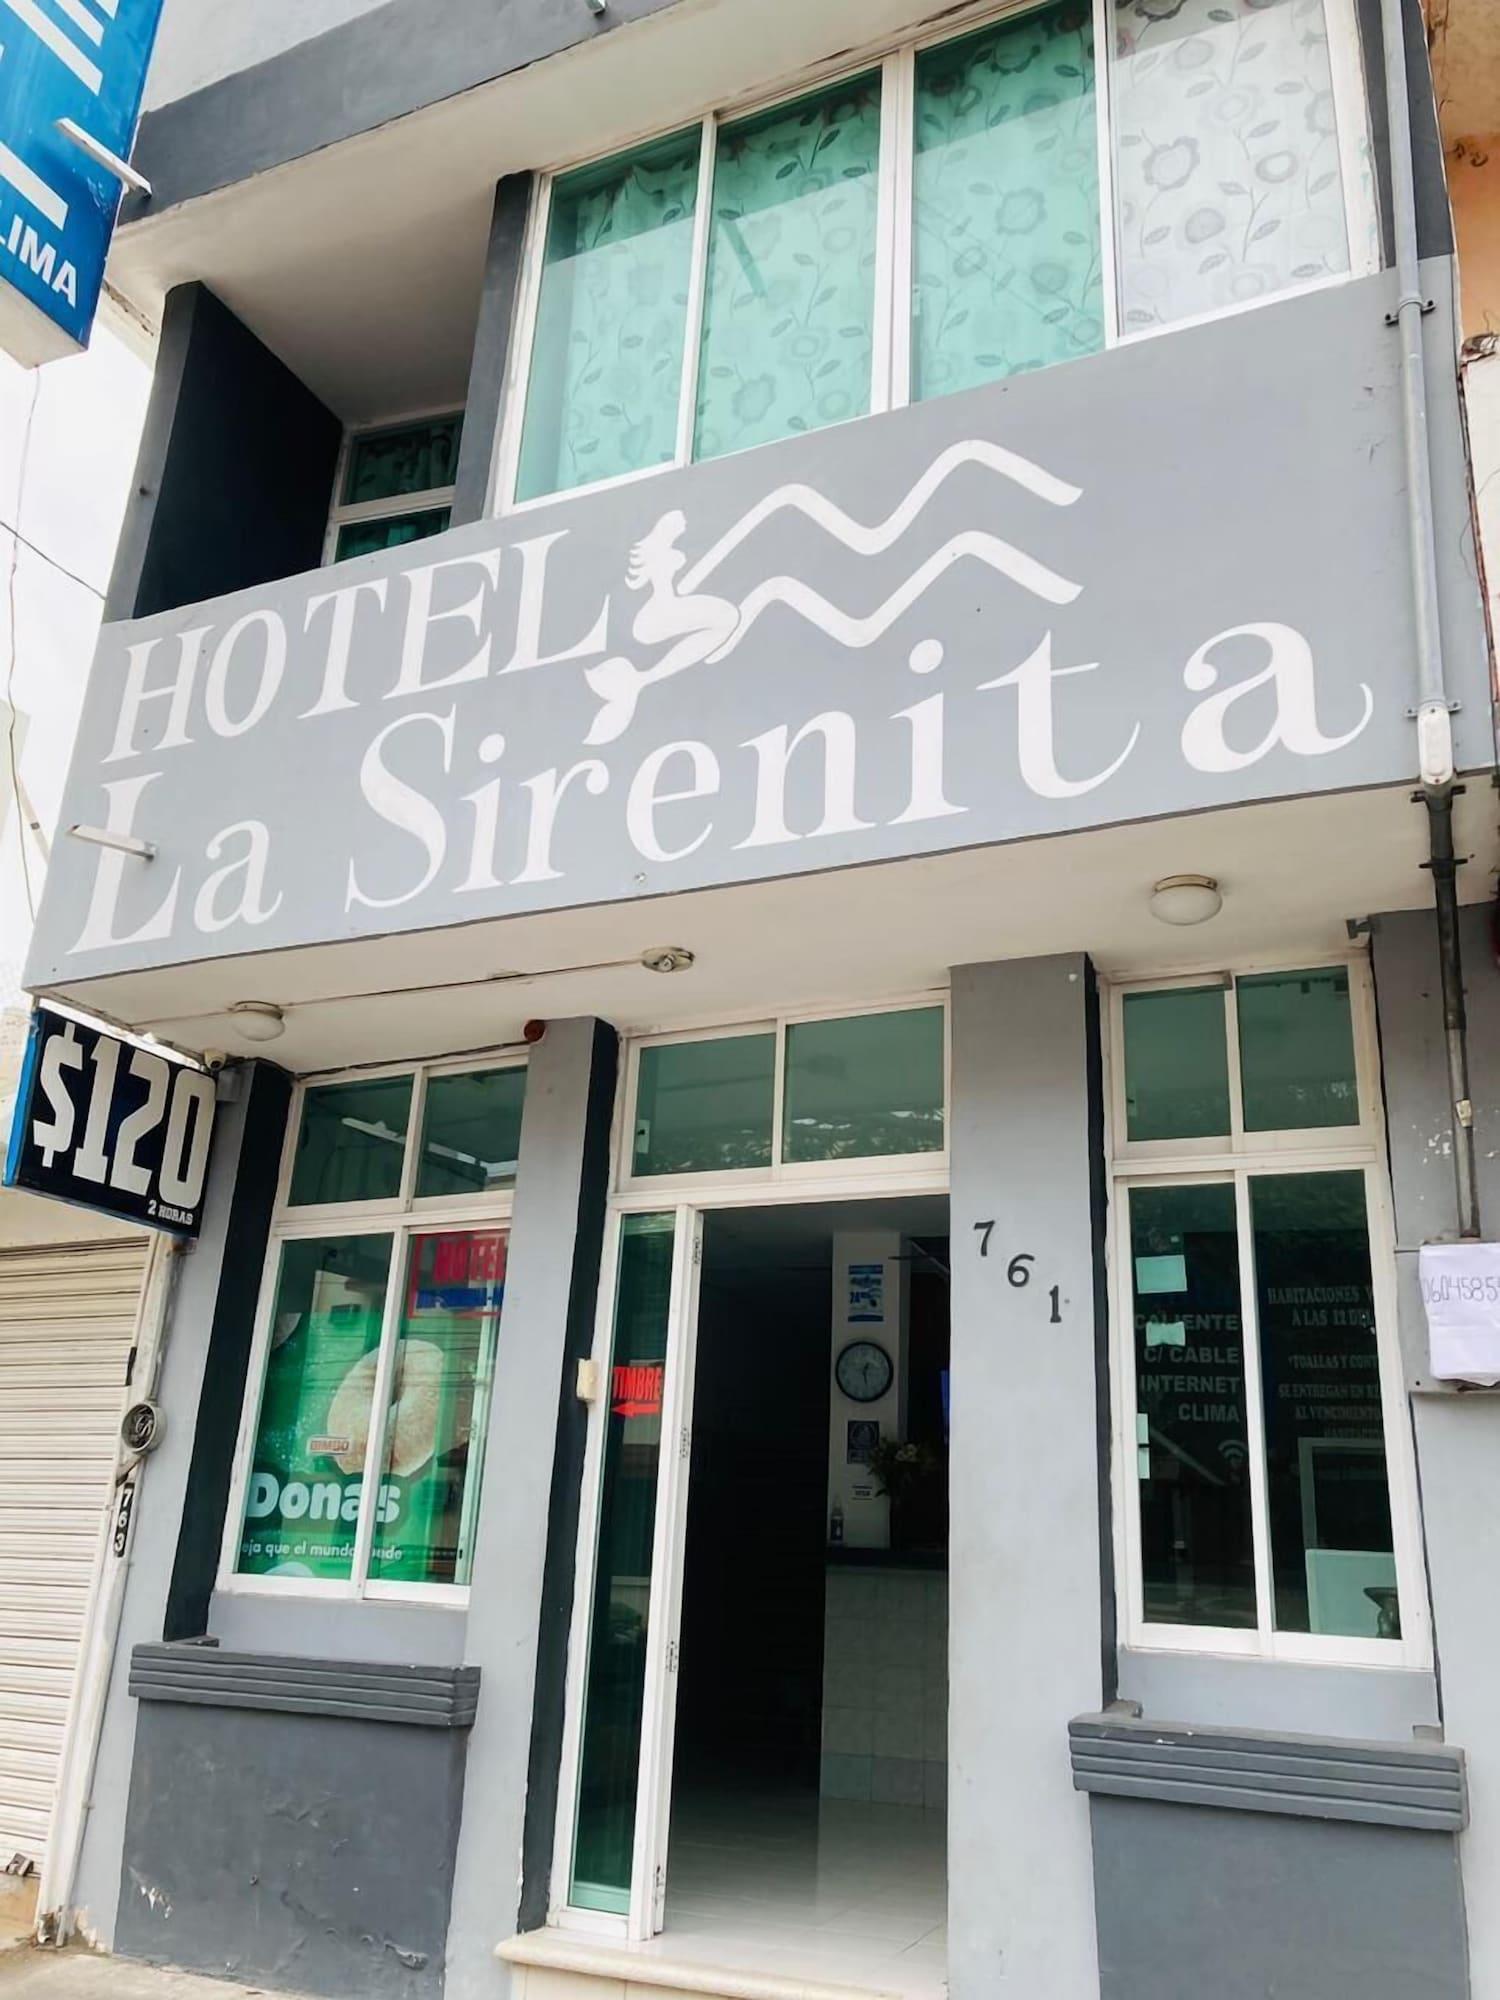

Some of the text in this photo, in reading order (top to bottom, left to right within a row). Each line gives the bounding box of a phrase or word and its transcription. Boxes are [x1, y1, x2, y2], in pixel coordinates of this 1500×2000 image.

[0, 213, 76, 308] IMA
[101, 530, 610, 764] HOTEL
[66, 622, 1374, 955] La Sirenita
[33, 1021, 217, 1209] $120
[148, 1199, 194, 1225] 2 HORAS
[973, 1219, 1063, 1324] 761
[1169, 1347, 1240, 1363] CABLE
[1139, 1376, 1241, 1394] INTERNET
[1178, 1403, 1241, 1423] CLIMA
[114, 1488, 134, 1553] 763
[246, 1472, 401, 1524] Donas
[265, 1543, 290, 1558] que
[294, 1541, 306, 1555] el
